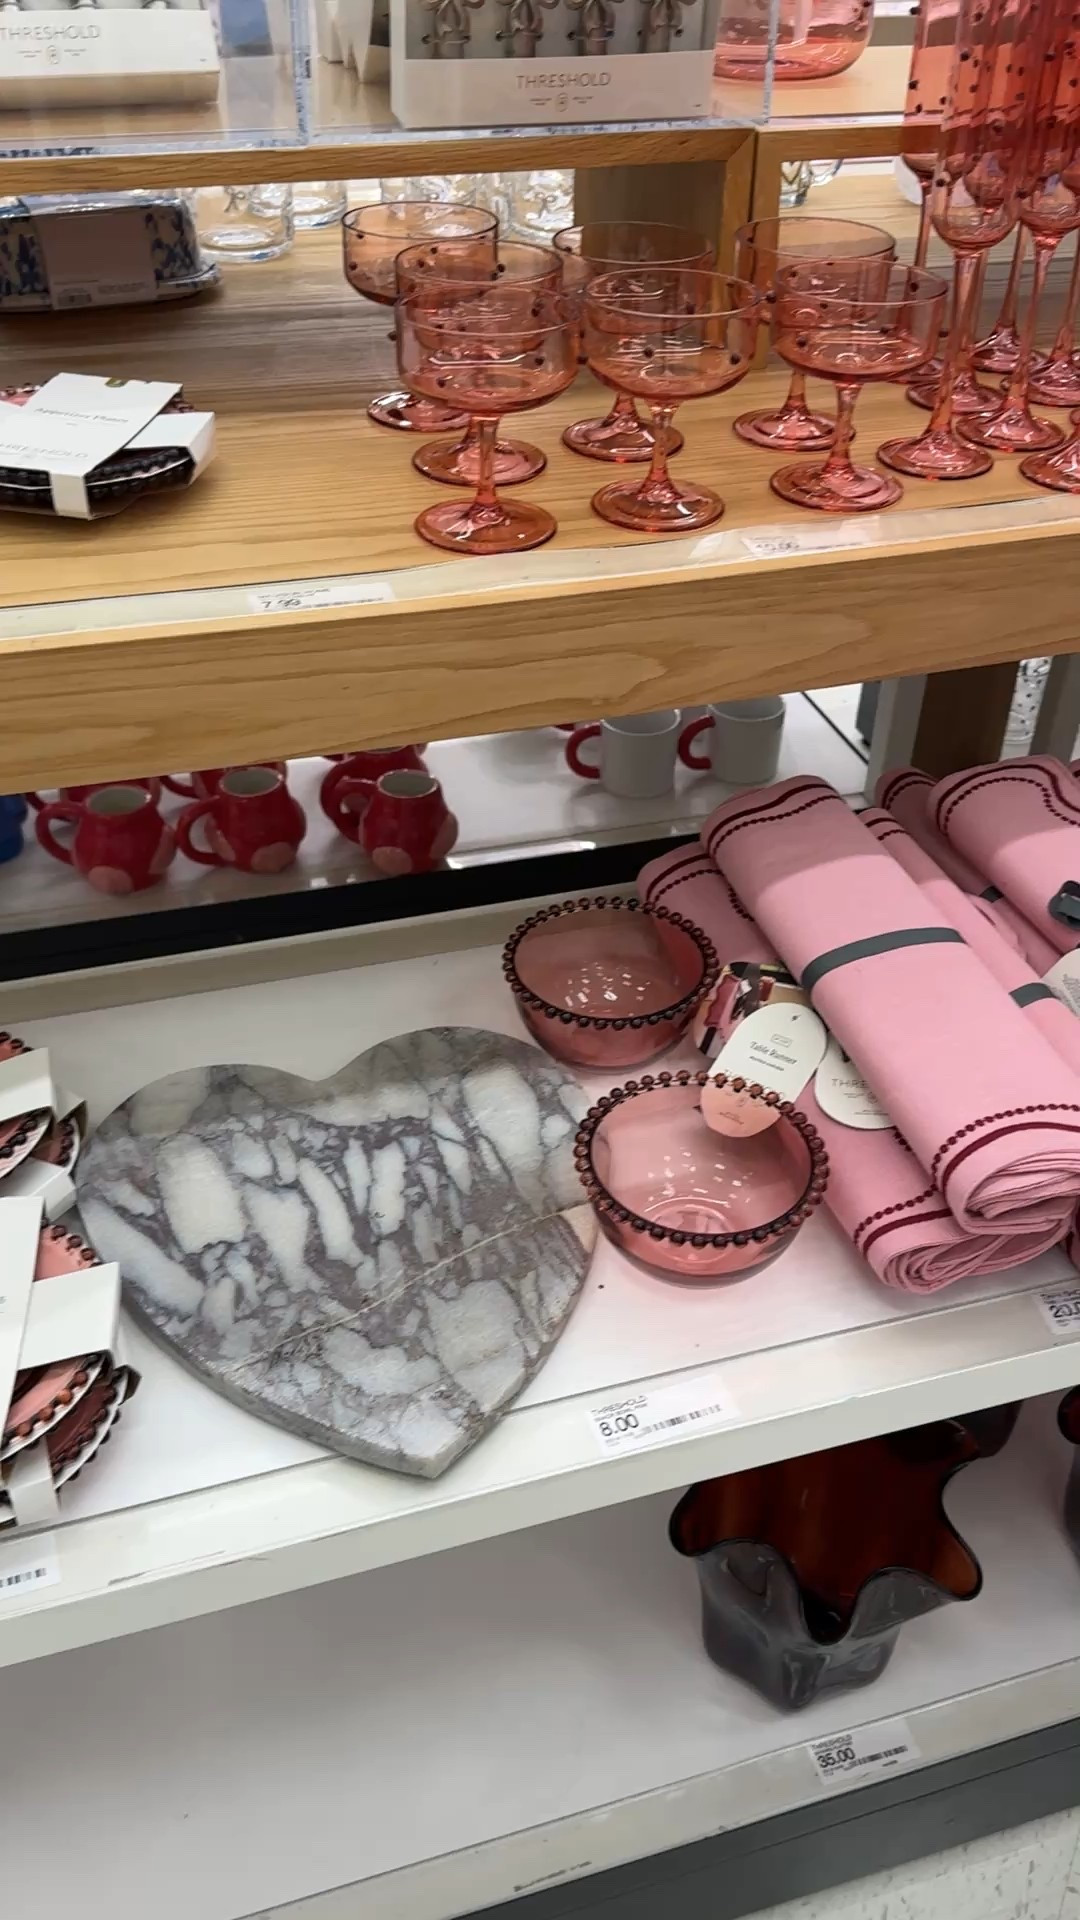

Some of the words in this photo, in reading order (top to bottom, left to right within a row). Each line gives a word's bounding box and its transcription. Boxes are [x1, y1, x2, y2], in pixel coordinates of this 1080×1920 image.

[516, 72, 611, 89] THRESHOLD
[591, 1395, 647, 1414] THRESHOLD
[599, 1413, 639, 1437] 8.00
[812, 1733, 853, 1750] THRESHOLD
[817, 1747, 856, 1769] 35.00
